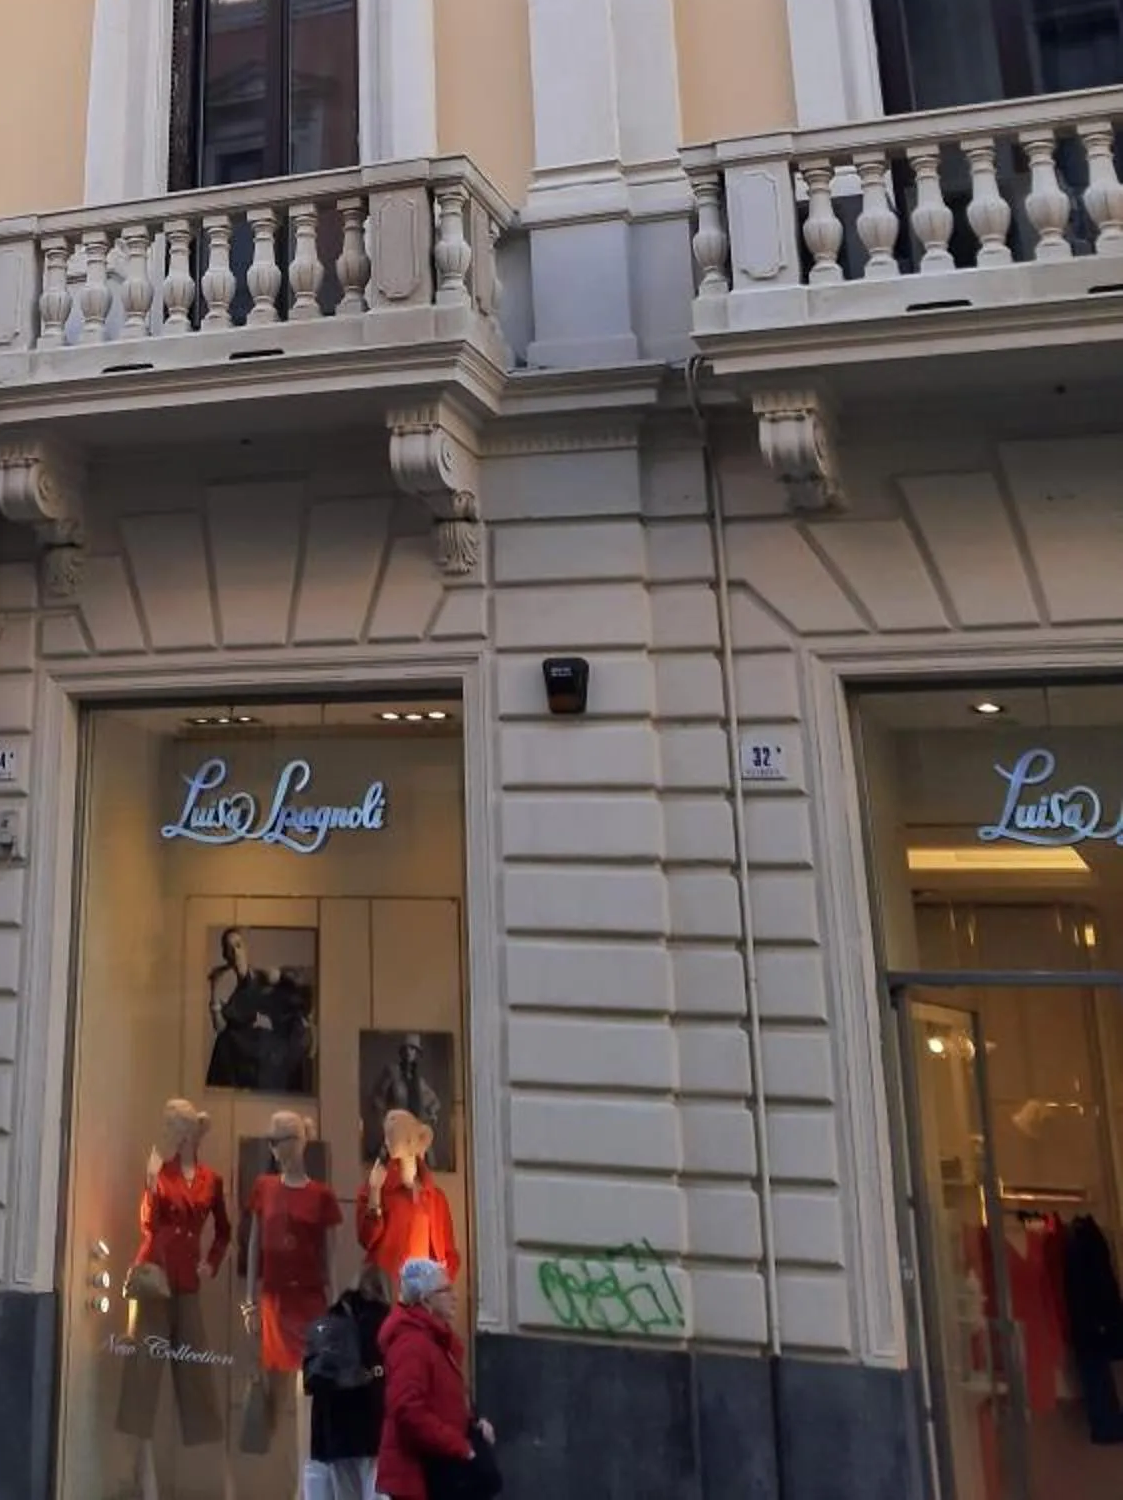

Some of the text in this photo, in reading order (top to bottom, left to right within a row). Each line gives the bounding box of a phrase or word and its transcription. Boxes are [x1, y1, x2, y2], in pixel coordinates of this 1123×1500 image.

[752, 746, 772, 767] 32
[161, 758, 386, 854] Luisa Spagnoli
[978, 748, 1101, 845] Luisa
[143, 1335, 235, 1366] Collection
